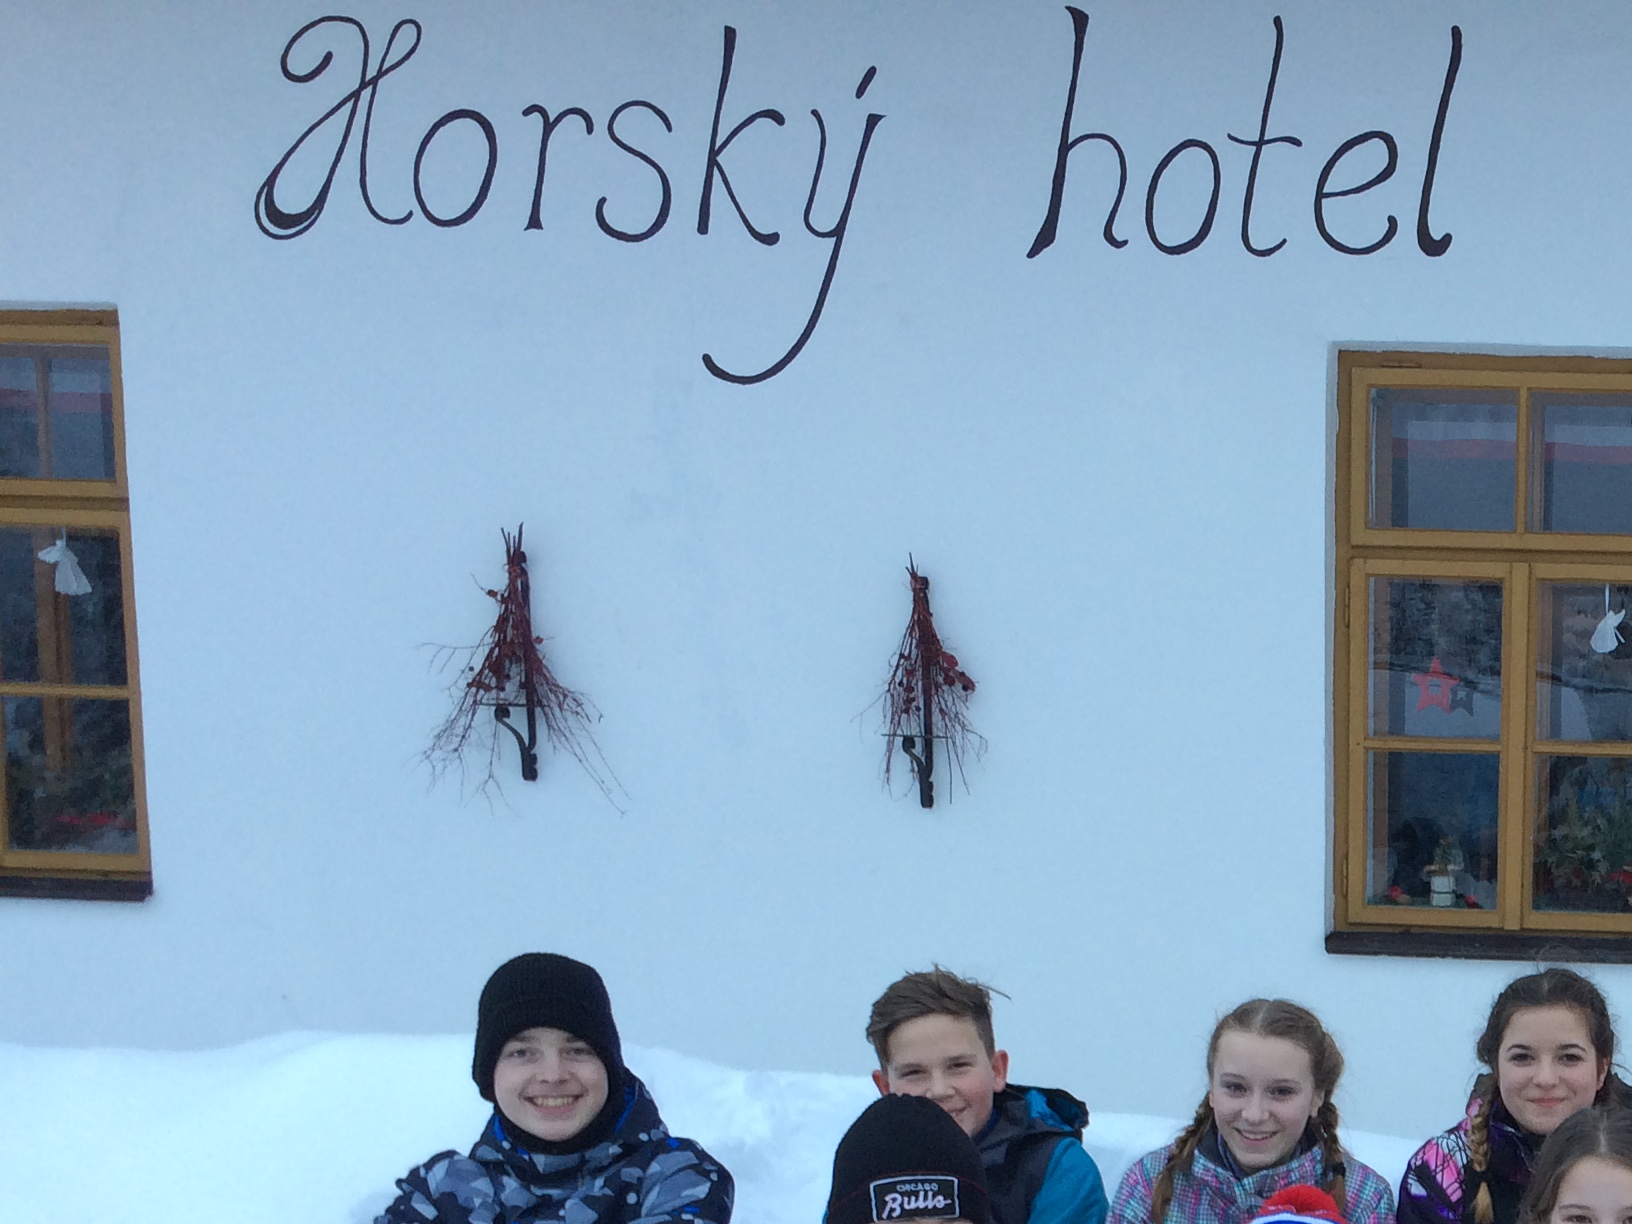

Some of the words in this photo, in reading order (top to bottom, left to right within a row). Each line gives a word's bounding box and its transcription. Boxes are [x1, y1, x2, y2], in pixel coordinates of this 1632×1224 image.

[255, 16, 885, 384] Horský
[1027, 6, 1462, 258] hotel
[881, 1191, 953, 1220] Bulls
